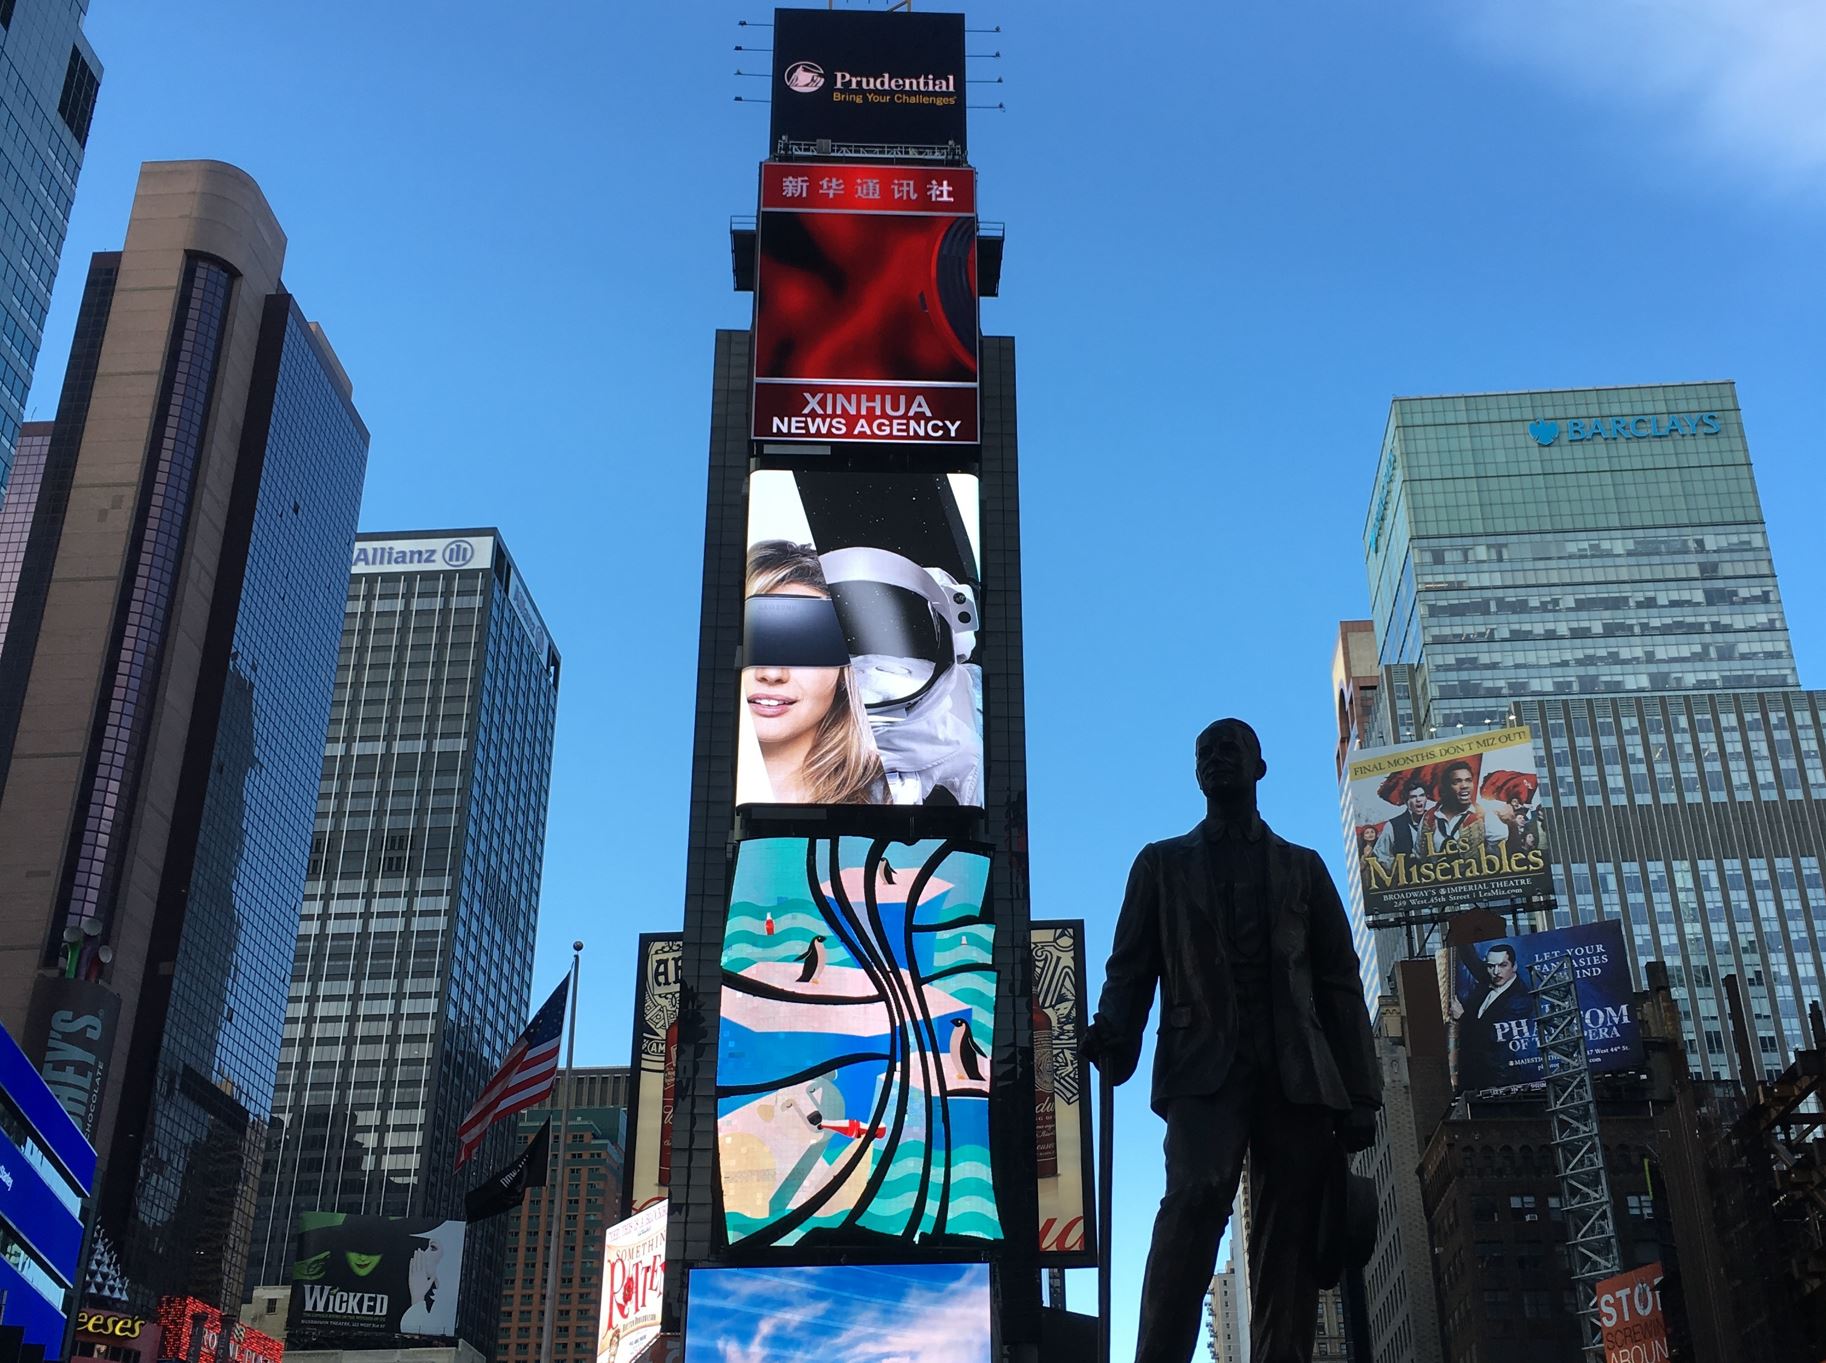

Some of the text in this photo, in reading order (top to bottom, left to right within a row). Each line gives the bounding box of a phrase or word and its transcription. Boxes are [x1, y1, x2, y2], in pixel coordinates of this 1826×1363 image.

[834, 71, 955, 92] Prudential
[833, 92, 956, 106] Bring Your Challenges
[782, 175, 954, 202] 新华通讯社
[802, 392, 932, 417] XINHUA
[772, 416, 961, 437] NEWS AGENCY
[1567, 411, 1721, 442] BARCLAYS
[353, 546, 437, 566] Allianz
[1354, 762, 1386, 776] FINAL
[1476, 736, 1497, 749] MIZ
[1498, 730, 1526, 744] OUT!
[1425, 831, 1469, 857] Les
[1365, 841, 1545, 890] Misérables
[1383, 878, 1532, 902] BROADWAY'S IMPERIAL THEATRE
[1449, 892, 1470, 901] Street
[1535, 943, 1606, 962] LET YOUR
[1508, 1037, 1530, 1052] OF
